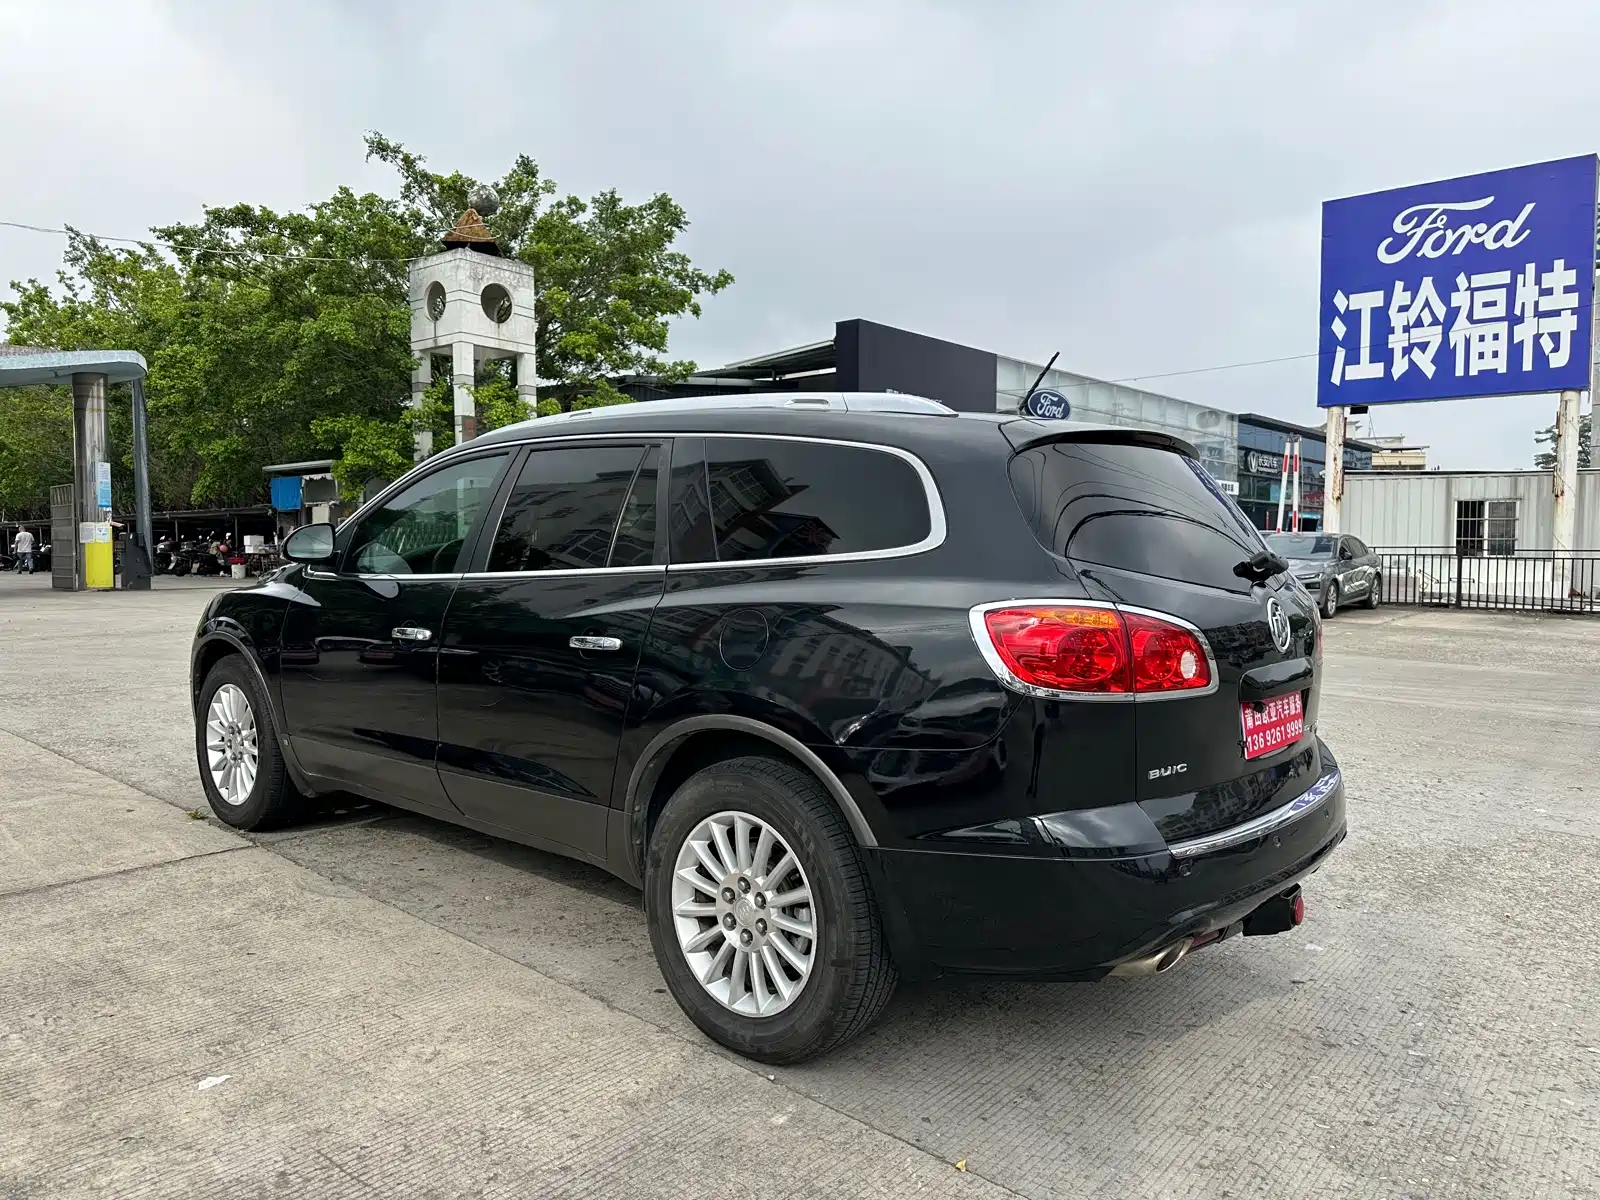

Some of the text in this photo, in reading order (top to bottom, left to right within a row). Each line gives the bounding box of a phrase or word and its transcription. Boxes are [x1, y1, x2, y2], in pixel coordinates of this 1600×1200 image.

[1377, 195, 1536, 264] Ford
[1330, 258, 1579, 387] 江铃福特
[1036, 393, 1065, 418] Ford
[1247, 731, 1265, 752] 136
[1265, 725, 1286, 746] 9261
[1287, 719, 1303, 739] 9999
[1148, 763, 1187, 780] BUIC
